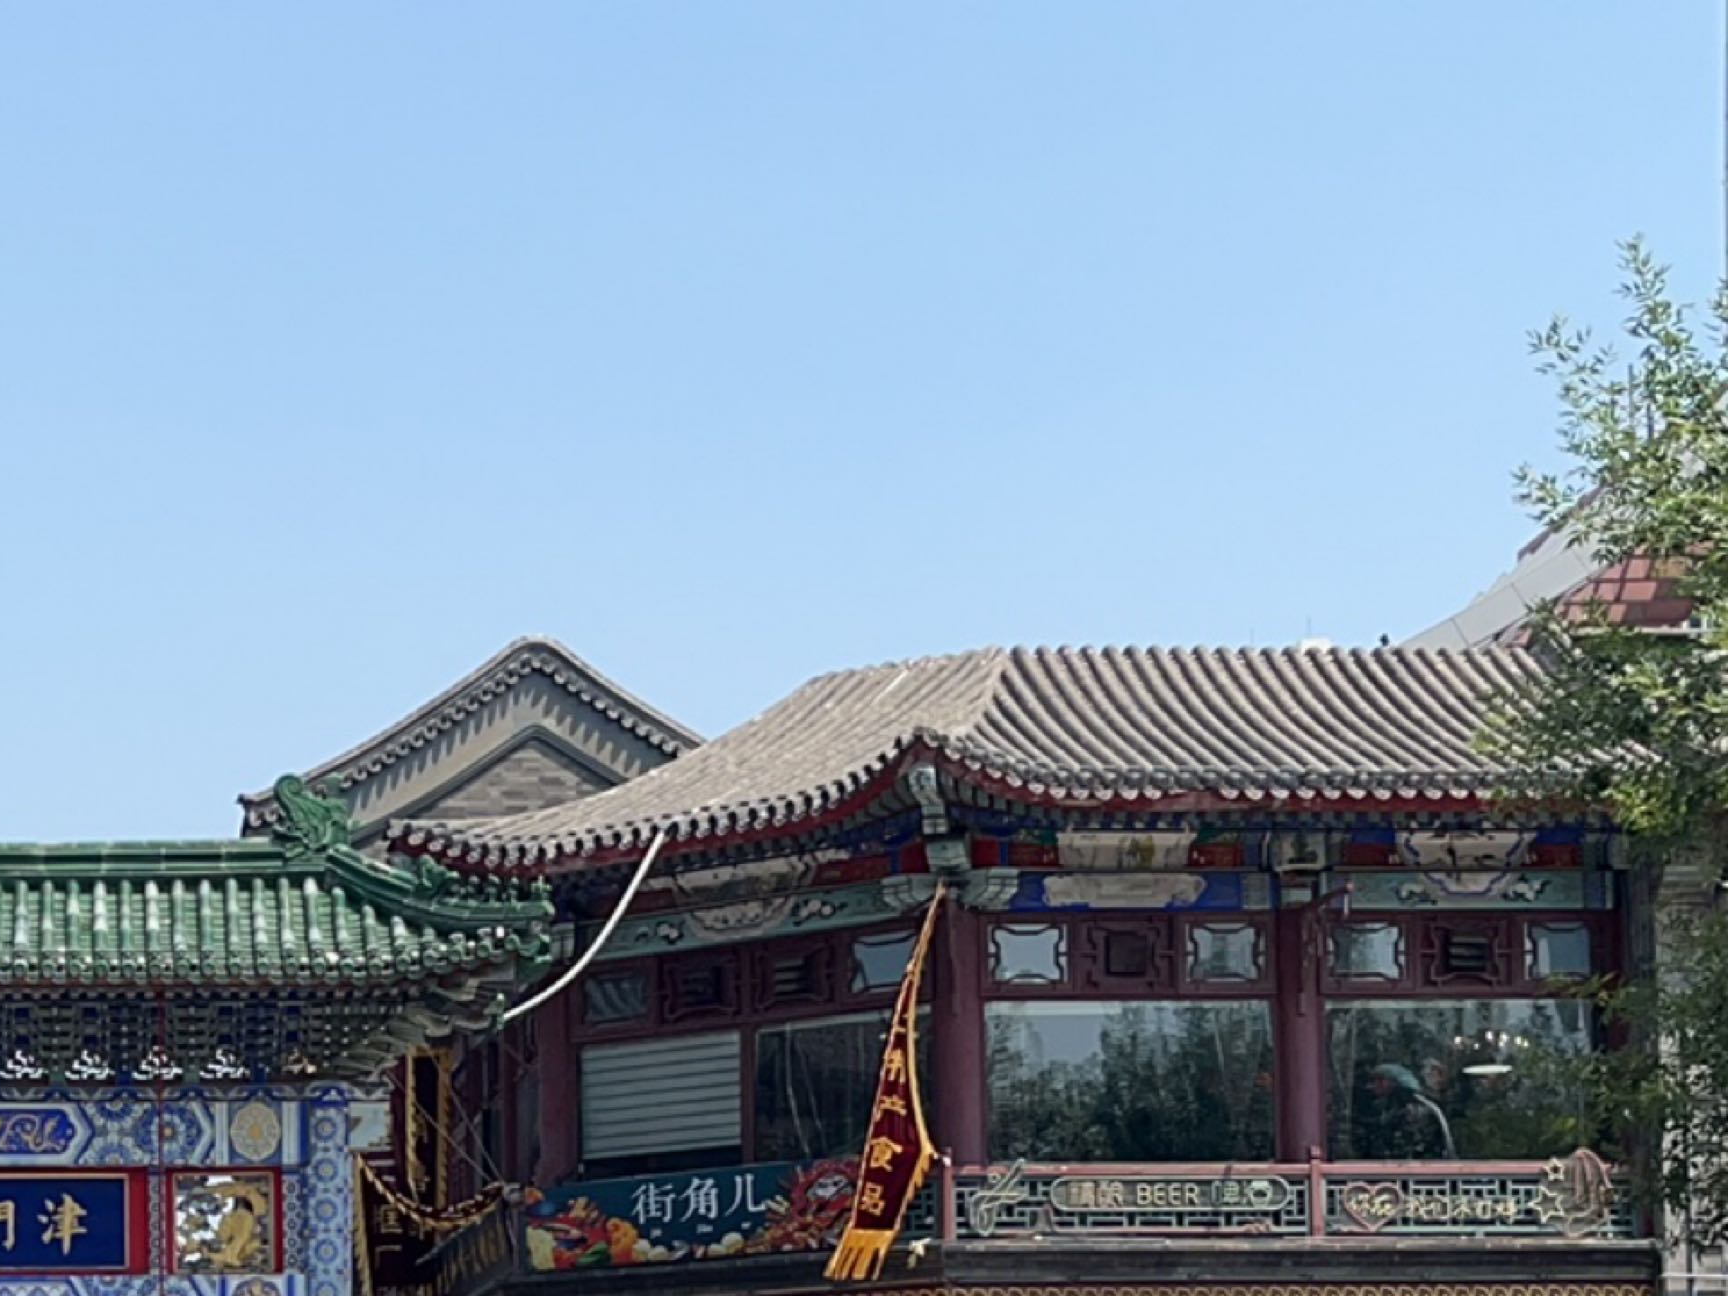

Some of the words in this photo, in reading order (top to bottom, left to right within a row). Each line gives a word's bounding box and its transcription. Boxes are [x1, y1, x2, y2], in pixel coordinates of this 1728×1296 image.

[631, 1173, 767, 1225] 街角儿
[1136, 1183, 1200, 1206] BEER
